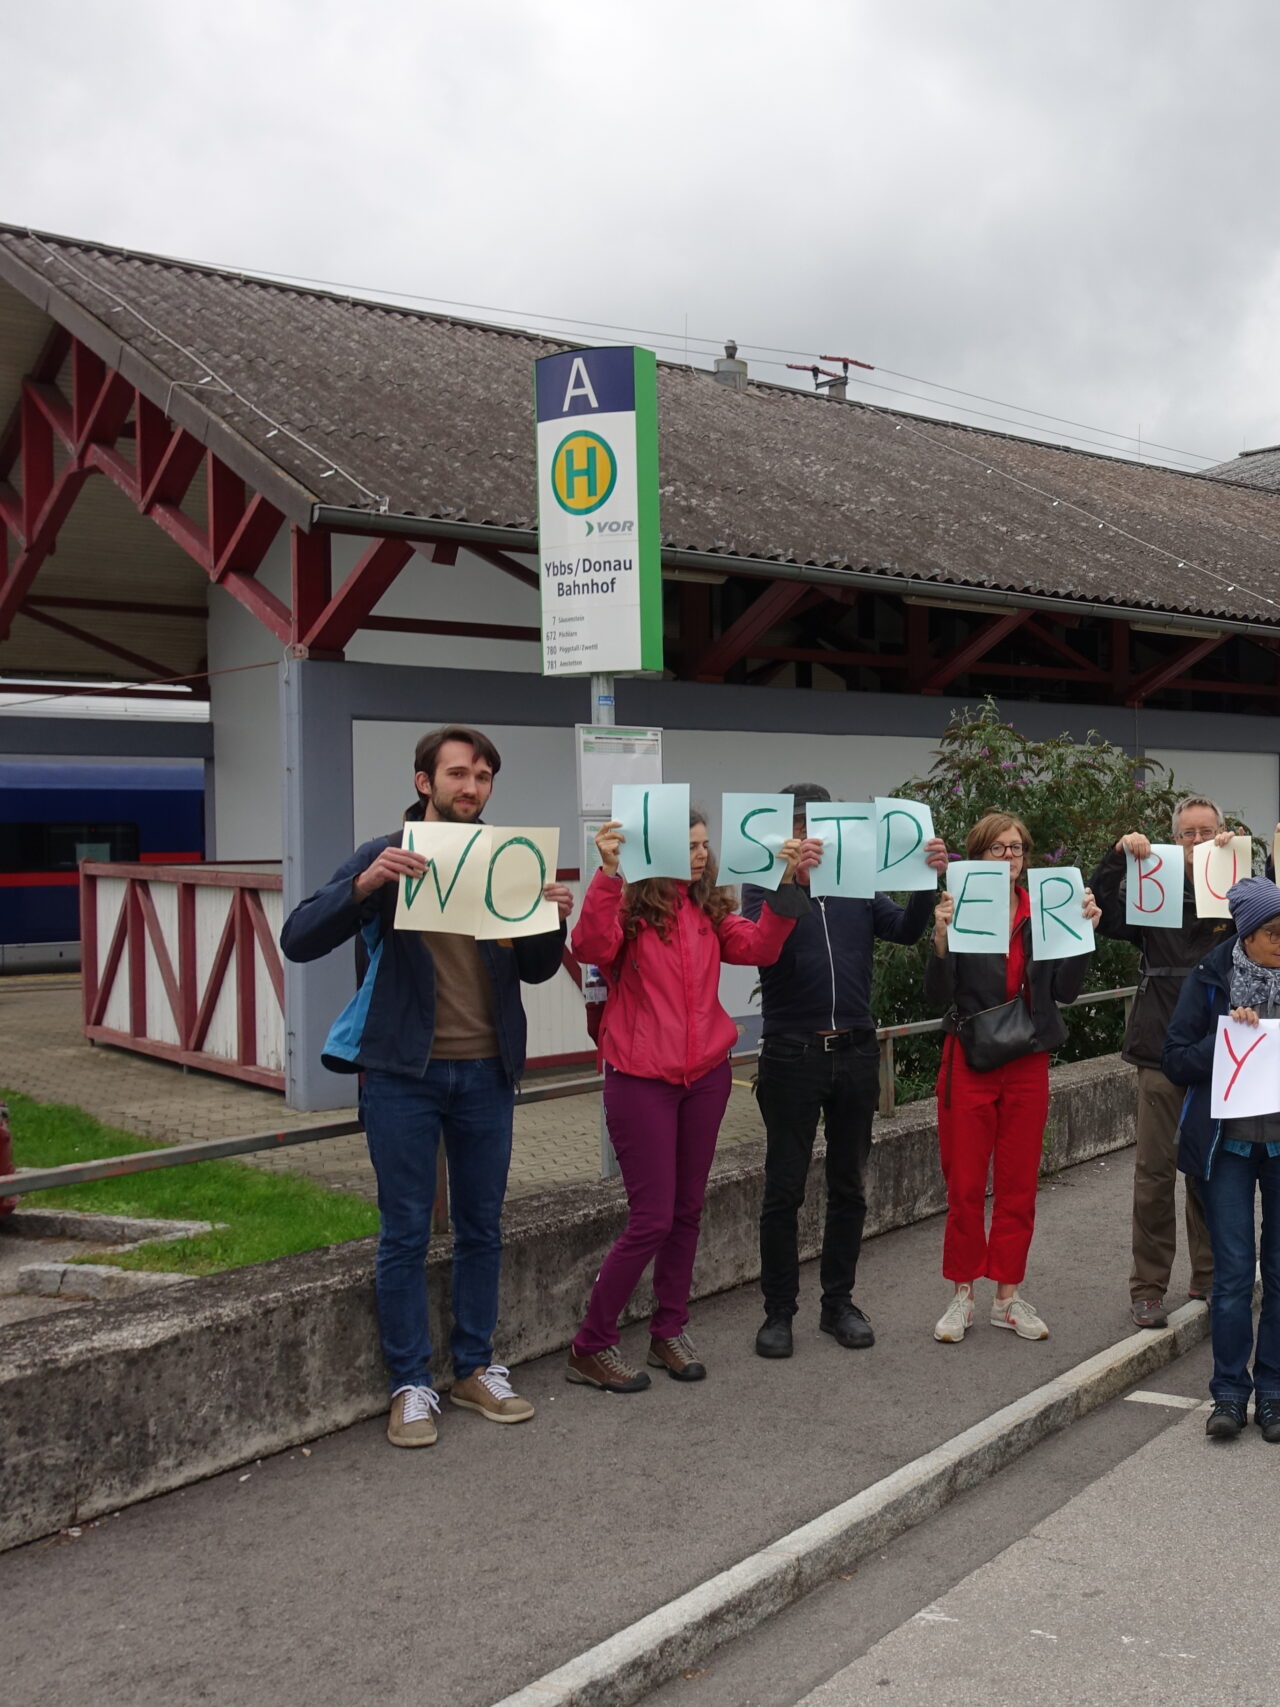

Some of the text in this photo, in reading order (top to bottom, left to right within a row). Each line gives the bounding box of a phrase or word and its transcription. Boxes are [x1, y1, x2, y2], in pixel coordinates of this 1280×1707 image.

[562, 357, 599, 412] A
[565, 446, 597, 499] H
[597, 520, 635, 533] VOR
[545, 558, 633, 578] Ybbs/Donau
[557, 577, 616, 597] Bahnhof
[546, 630, 556, 641] 672
[546, 645, 557, 655] 780
[546, 660, 557, 670] 781
